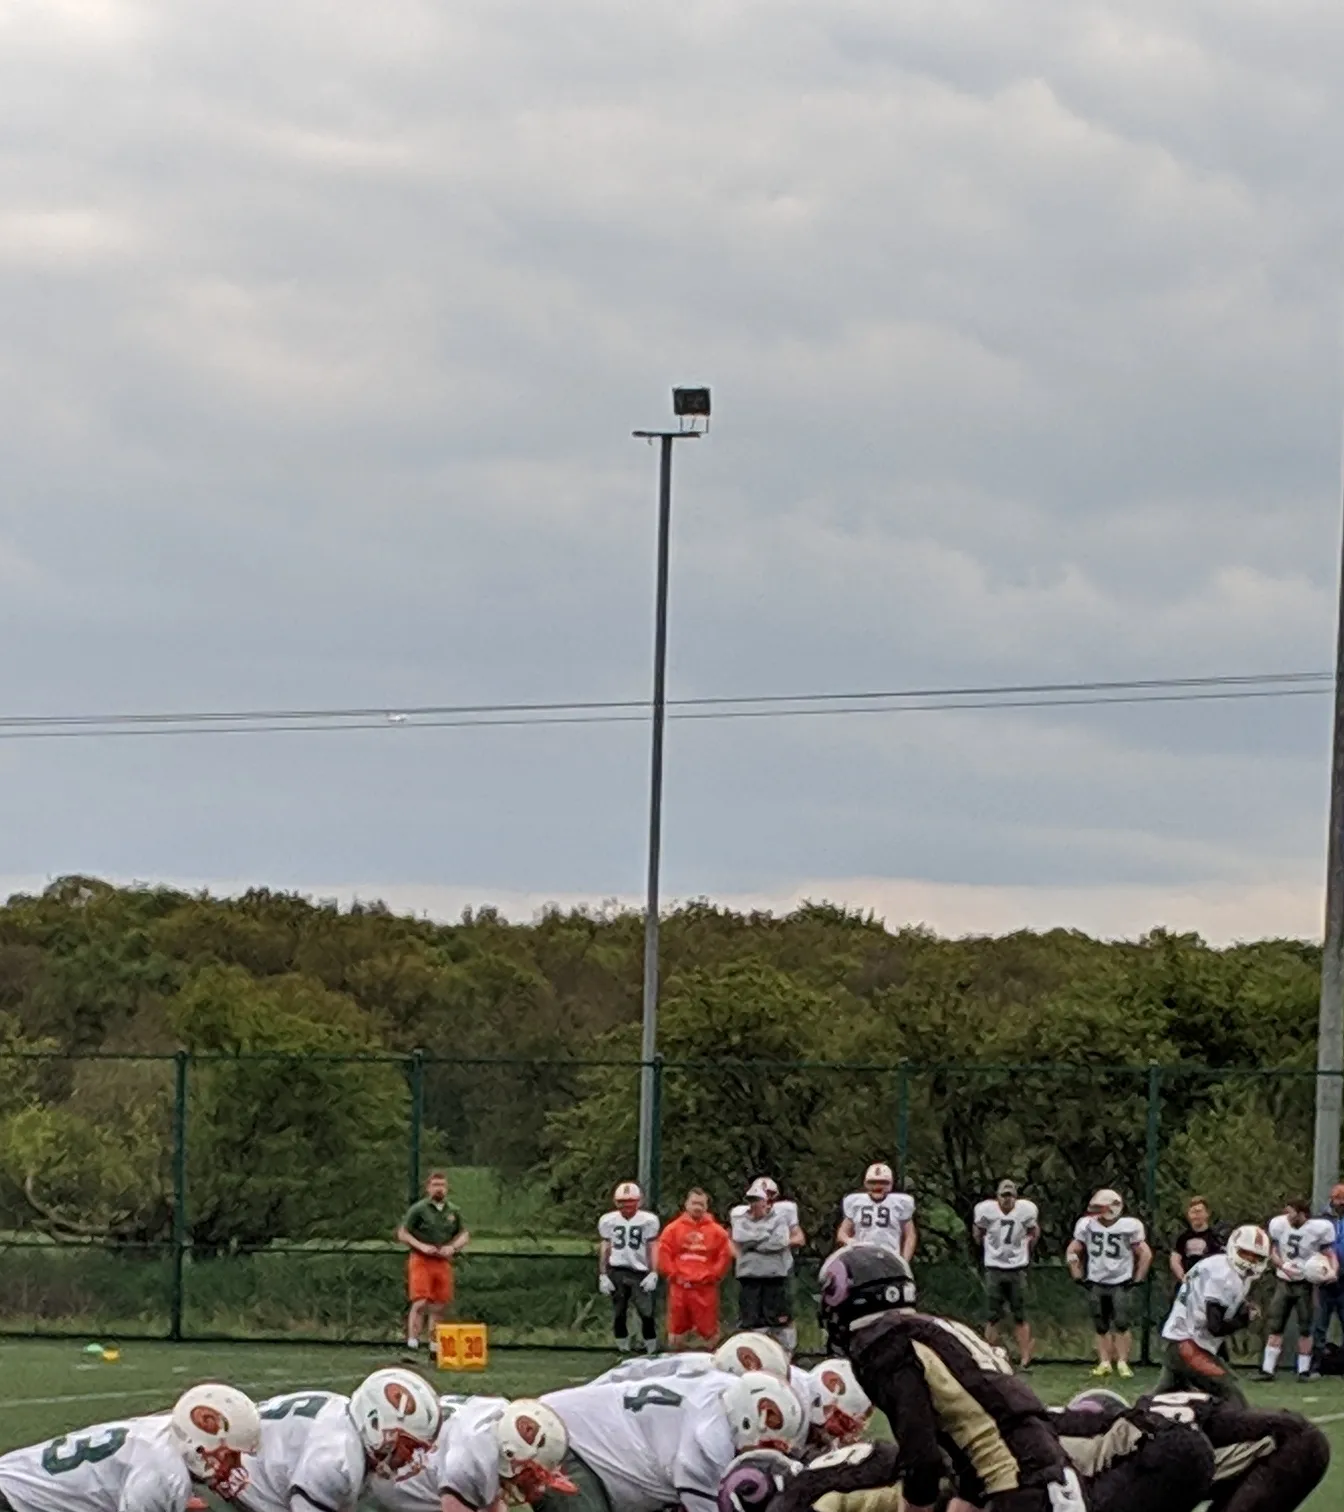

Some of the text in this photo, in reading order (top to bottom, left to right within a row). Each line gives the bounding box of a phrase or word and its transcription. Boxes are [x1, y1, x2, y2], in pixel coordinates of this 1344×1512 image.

[613, 1225, 642, 1250] 39
[1000, 1219, 1014, 1244] 7
[1091, 1232, 1122, 1259] 55
[1287, 1234, 1303, 1259] 5
